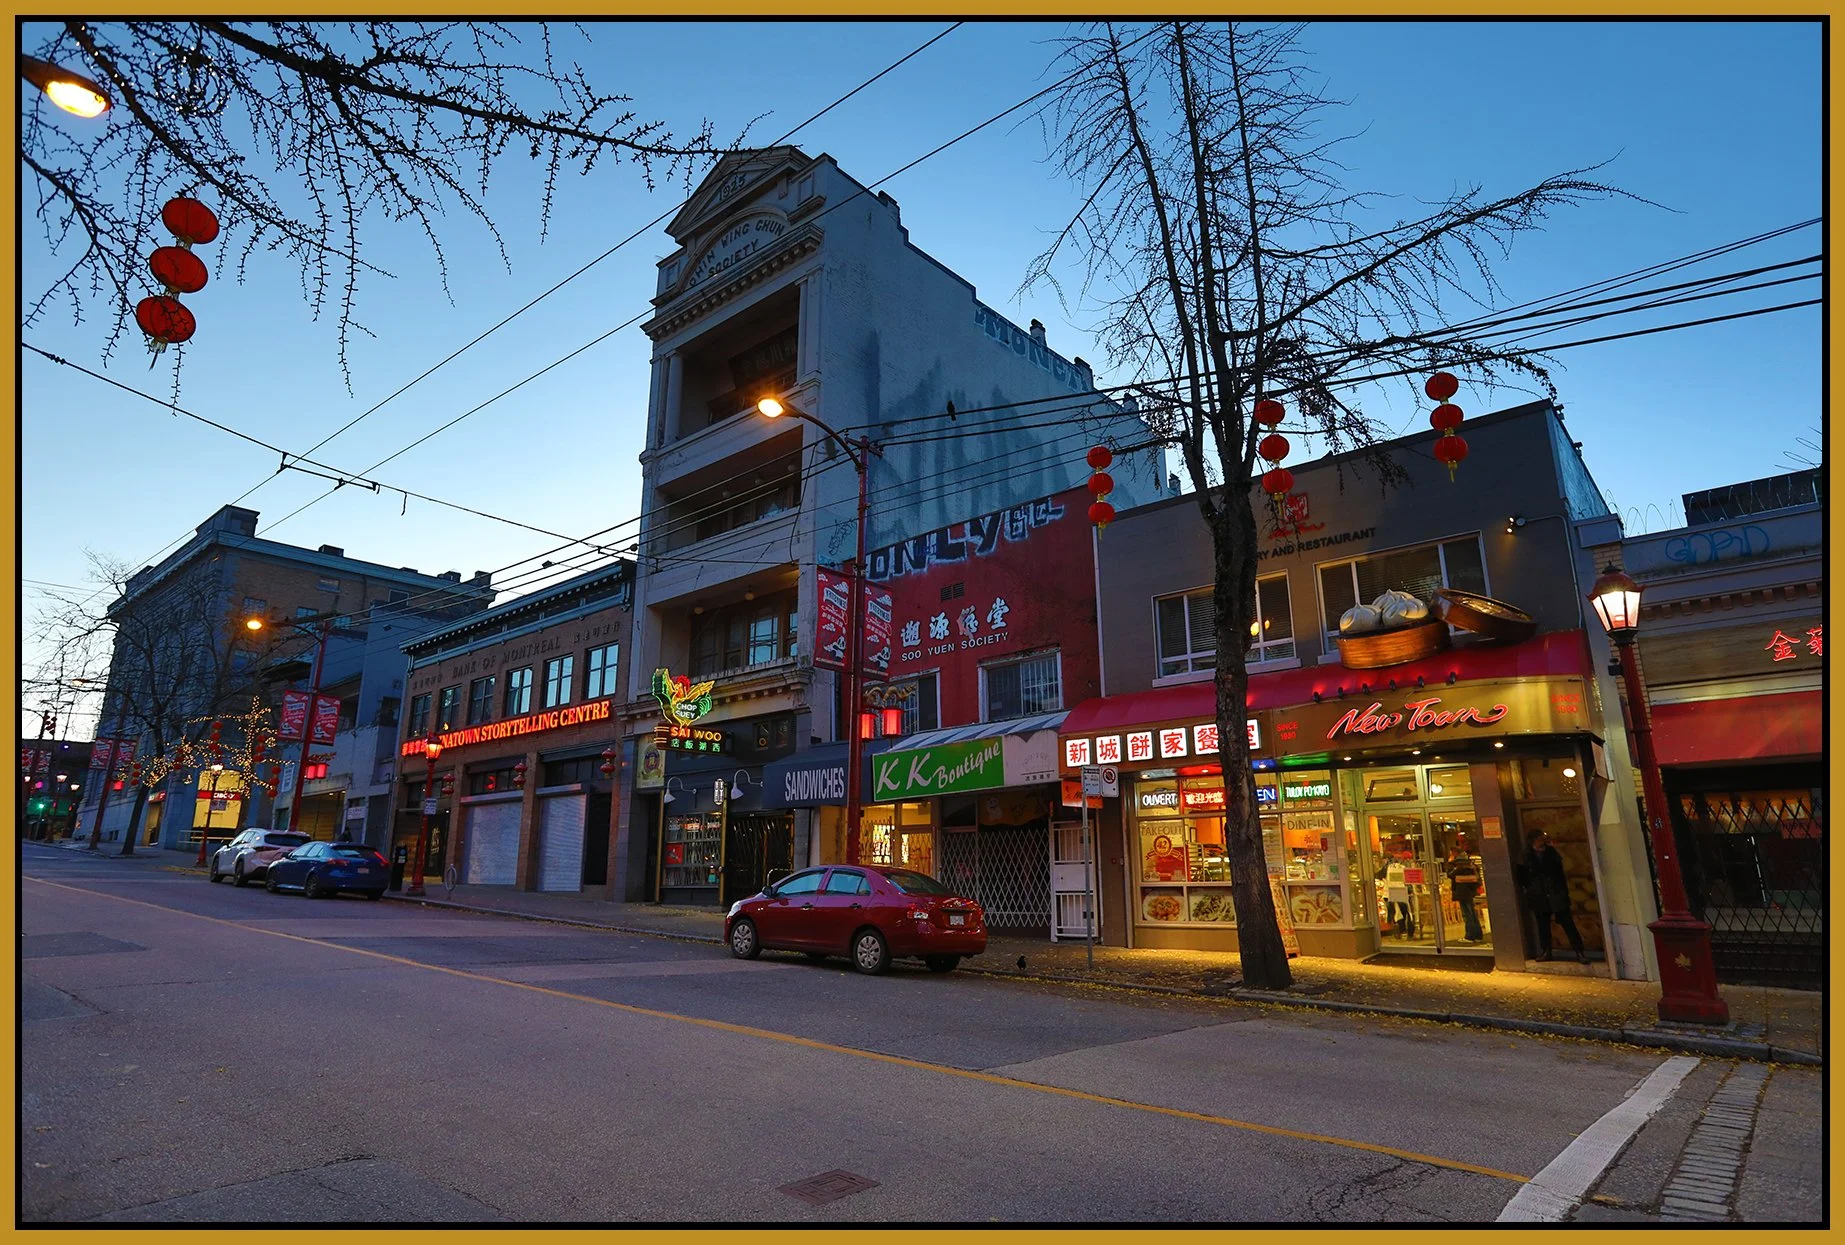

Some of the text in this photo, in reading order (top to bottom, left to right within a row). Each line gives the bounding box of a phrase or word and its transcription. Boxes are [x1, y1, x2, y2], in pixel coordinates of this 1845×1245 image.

[719, 174, 746, 200] 1925
[689, 218, 785, 288] CHIN WING CHUN
[708, 239, 759, 278] SOCIETY
[1271, 543, 1294, 558] AND
[1297, 528, 1376, 552] RESTAURANT
[452, 636, 561, 679] BANK OF MONTREAL
[901, 632, 1008, 661] SOO YUEN SOCIETY
[481, 711, 558, 743] STORYTELLING
[560, 700, 610, 727] CENTRE
[675, 710, 696, 719] SUEY
[676, 703, 698, 711] CHOP
[1327, 697, 1509, 739] New Town
[670, 726, 722, 742] SAI WOO
[876, 740, 1001, 794] K K Boutique
[785, 766, 845, 802] SANDWICHES
[1256, 788, 1276, 801] EN
[1142, 793, 1177, 806] OUVERT
[1141, 825, 1184, 836] TAKEOUT
[1287, 820, 1330, 830] DINE-IN
